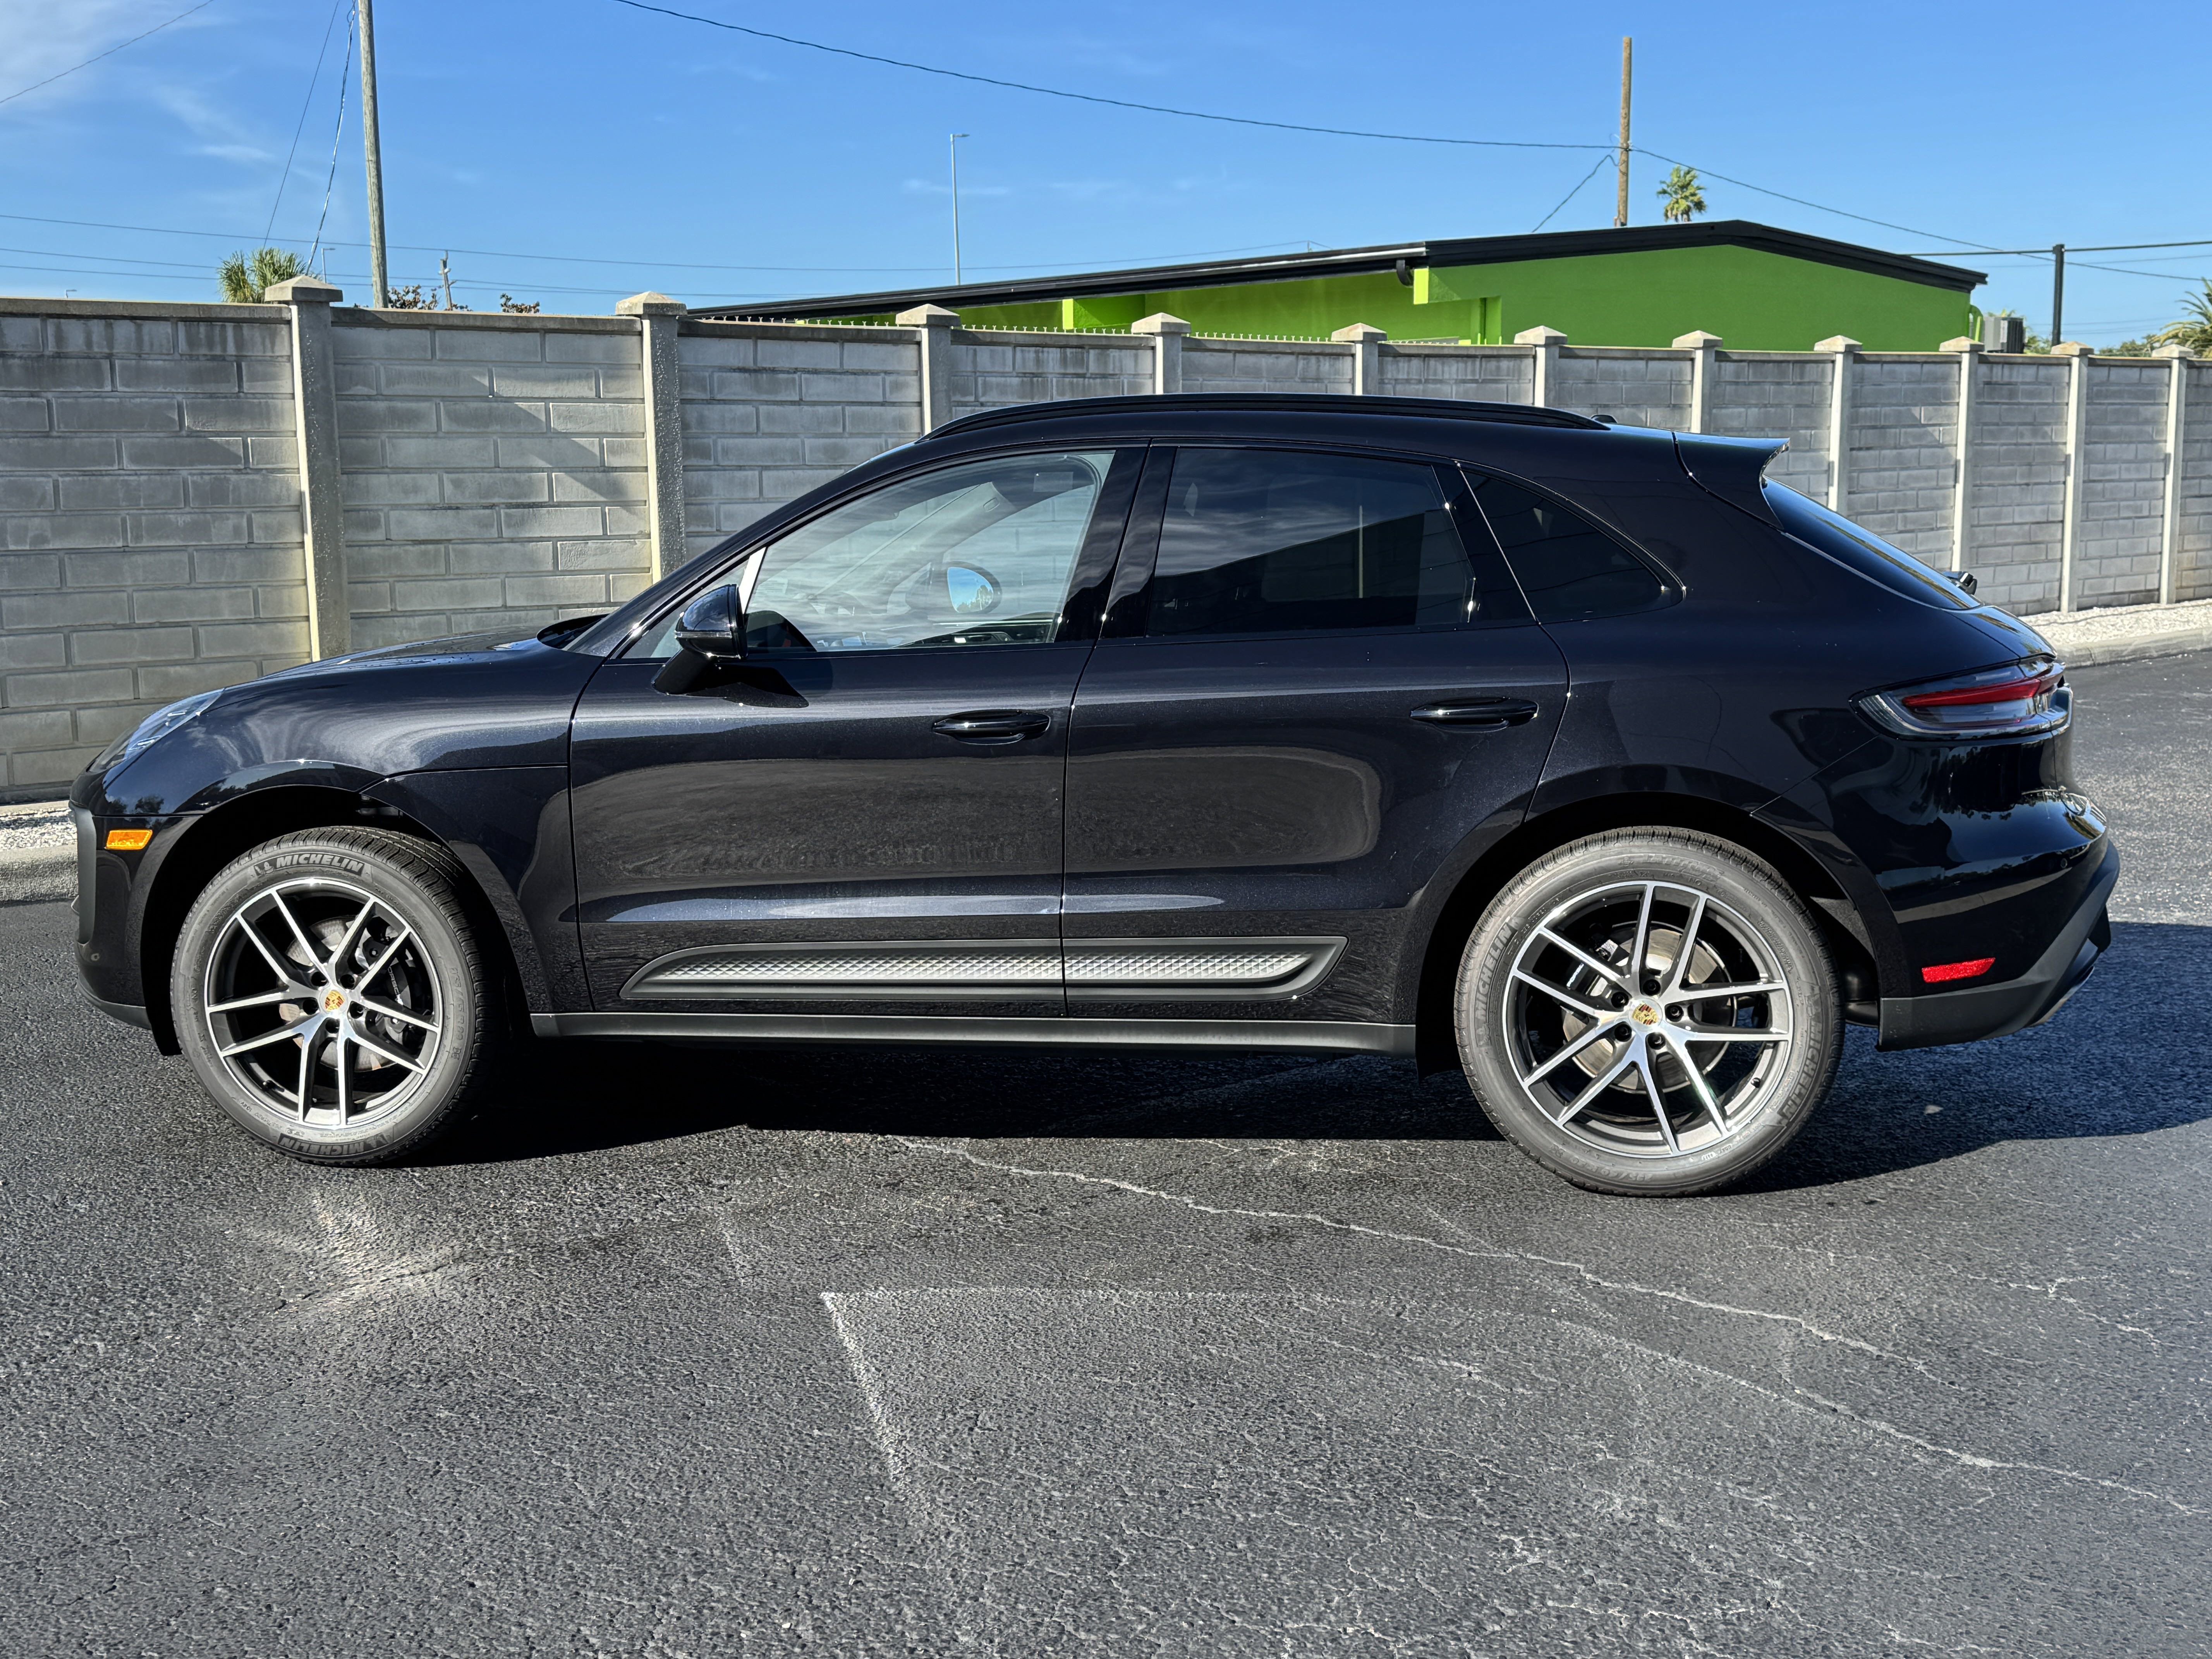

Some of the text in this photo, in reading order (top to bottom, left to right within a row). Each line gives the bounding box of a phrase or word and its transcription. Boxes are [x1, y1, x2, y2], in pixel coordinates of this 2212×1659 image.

[276, 854, 364, 872] MICHELIN
[1475, 923, 1512, 1020] MICHELIN
[1783, 1021, 1822, 1118] MICHELIN
[279, 1137, 364, 1156] MICHELIN
